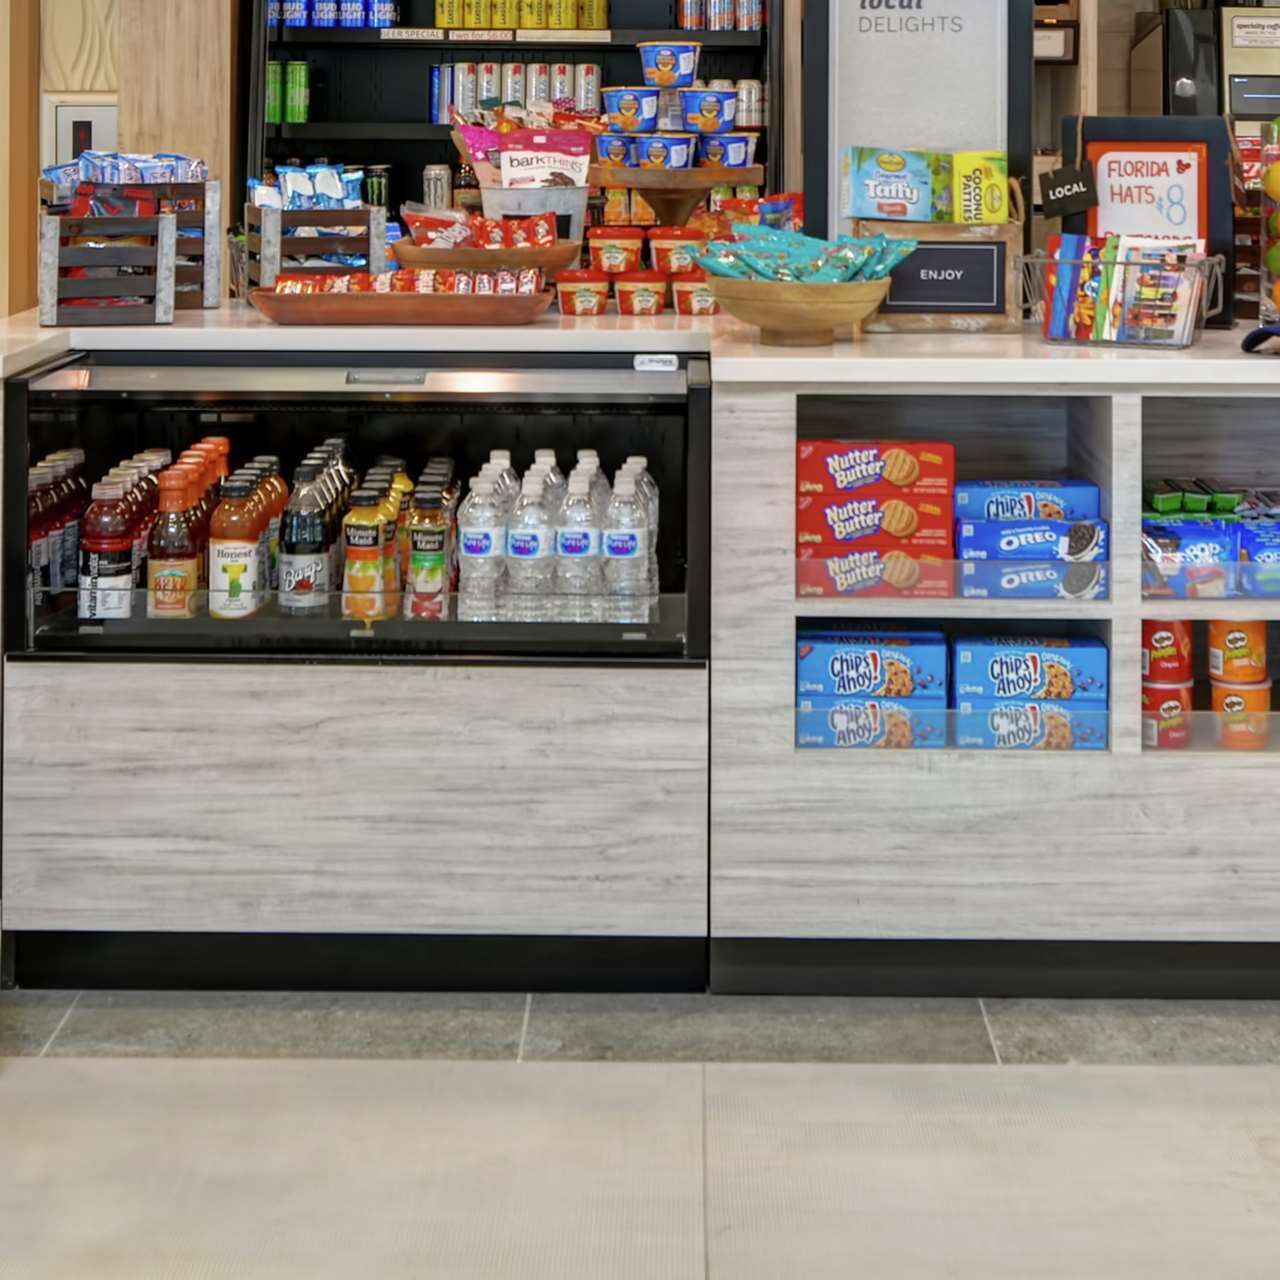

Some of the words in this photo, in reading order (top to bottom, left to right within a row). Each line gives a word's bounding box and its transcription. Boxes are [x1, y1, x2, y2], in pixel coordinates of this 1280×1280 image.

[858, 16, 963, 33] DELIGHTS
[1107, 161, 1169, 178] FLORIDA
[864, 180, 919, 204] Taffy
[1049, 181, 1087, 200] LOCAL
[1110, 184, 1155, 204] HATS
[920, 269, 963, 280] ENJOY
[826, 448, 878, 474] Nutter
[835, 461, 884, 488] Butter
[825, 499, 877, 525] Nutter
[833, 512, 883, 540] Butter
[1000, 531, 1057, 551] OREO
[826, 550, 878, 577] Nutter
[835, 563, 884, 591] Butter
[1001, 570, 1057, 589] OREO
